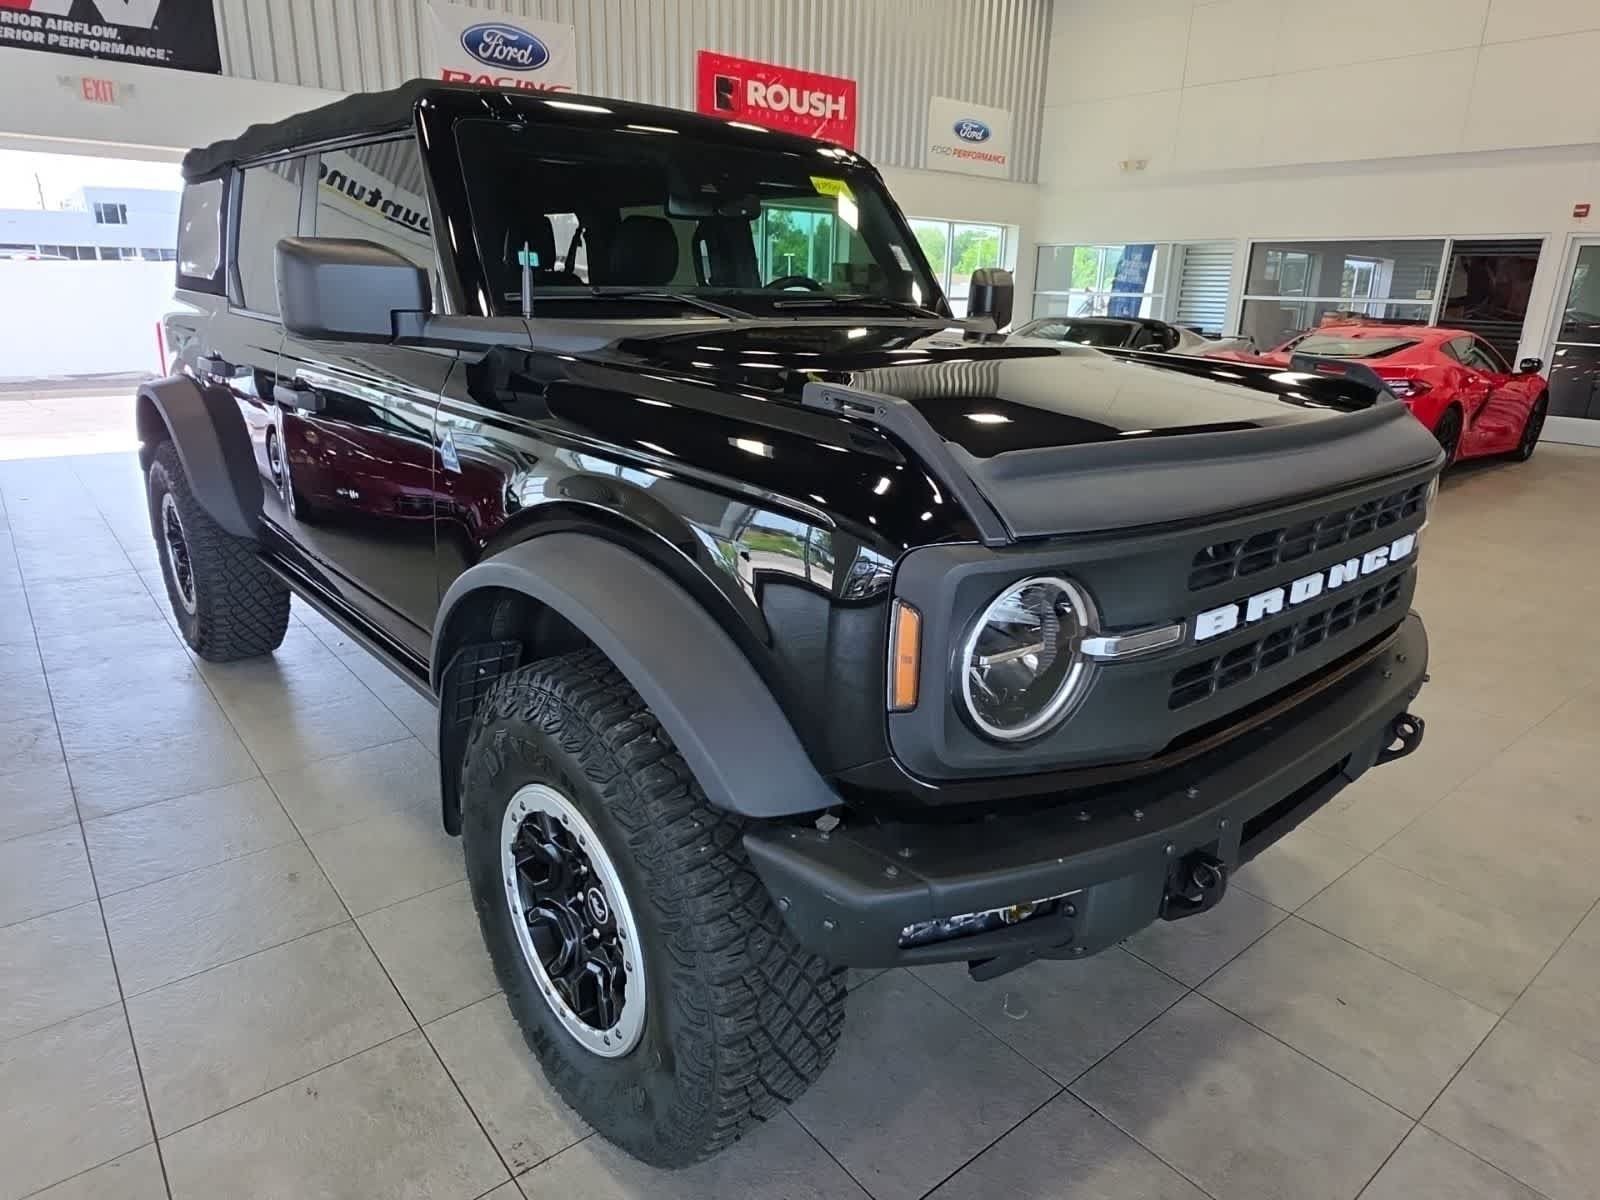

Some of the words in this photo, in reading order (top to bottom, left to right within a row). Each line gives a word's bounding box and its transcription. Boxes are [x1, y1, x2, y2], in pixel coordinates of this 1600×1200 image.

[0, 11, 42, 29] RIOR
[45, 17, 122, 40] AIRFLOW.
[479, 29, 533, 64] Ford
[82, 77, 115, 103] EXIT
[747, 80, 846, 120] ROUSH
[960, 122, 985, 140] Ford
[1194, 532, 1416, 641] BRONCO
